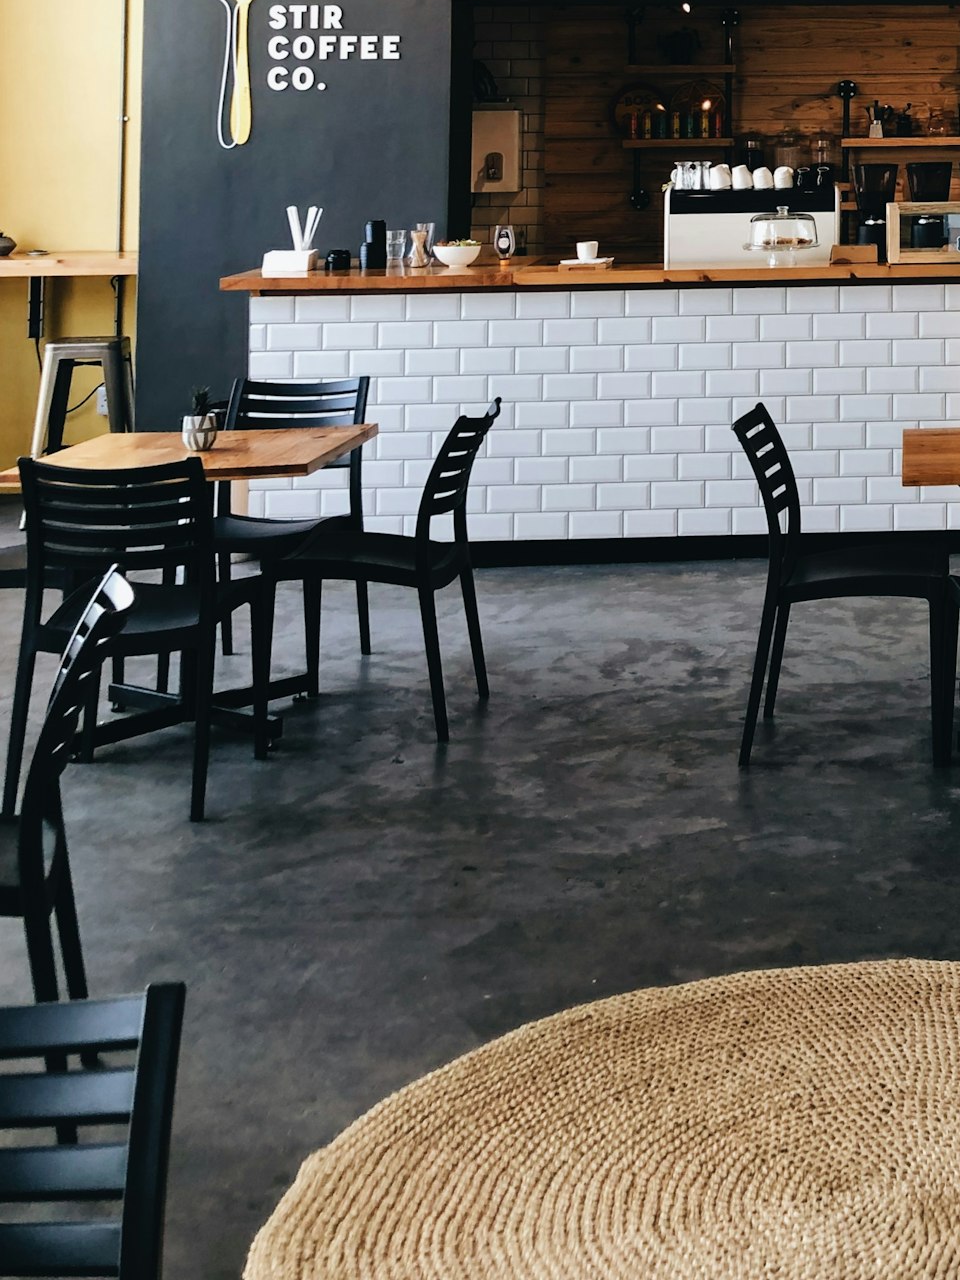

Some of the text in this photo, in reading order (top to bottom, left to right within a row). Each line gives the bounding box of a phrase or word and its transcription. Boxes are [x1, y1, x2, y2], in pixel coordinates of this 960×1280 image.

[268, 4, 343, 30] STIR
[267, 35, 400, 60] COFFEE
[267, 65, 327, 91] CO.
